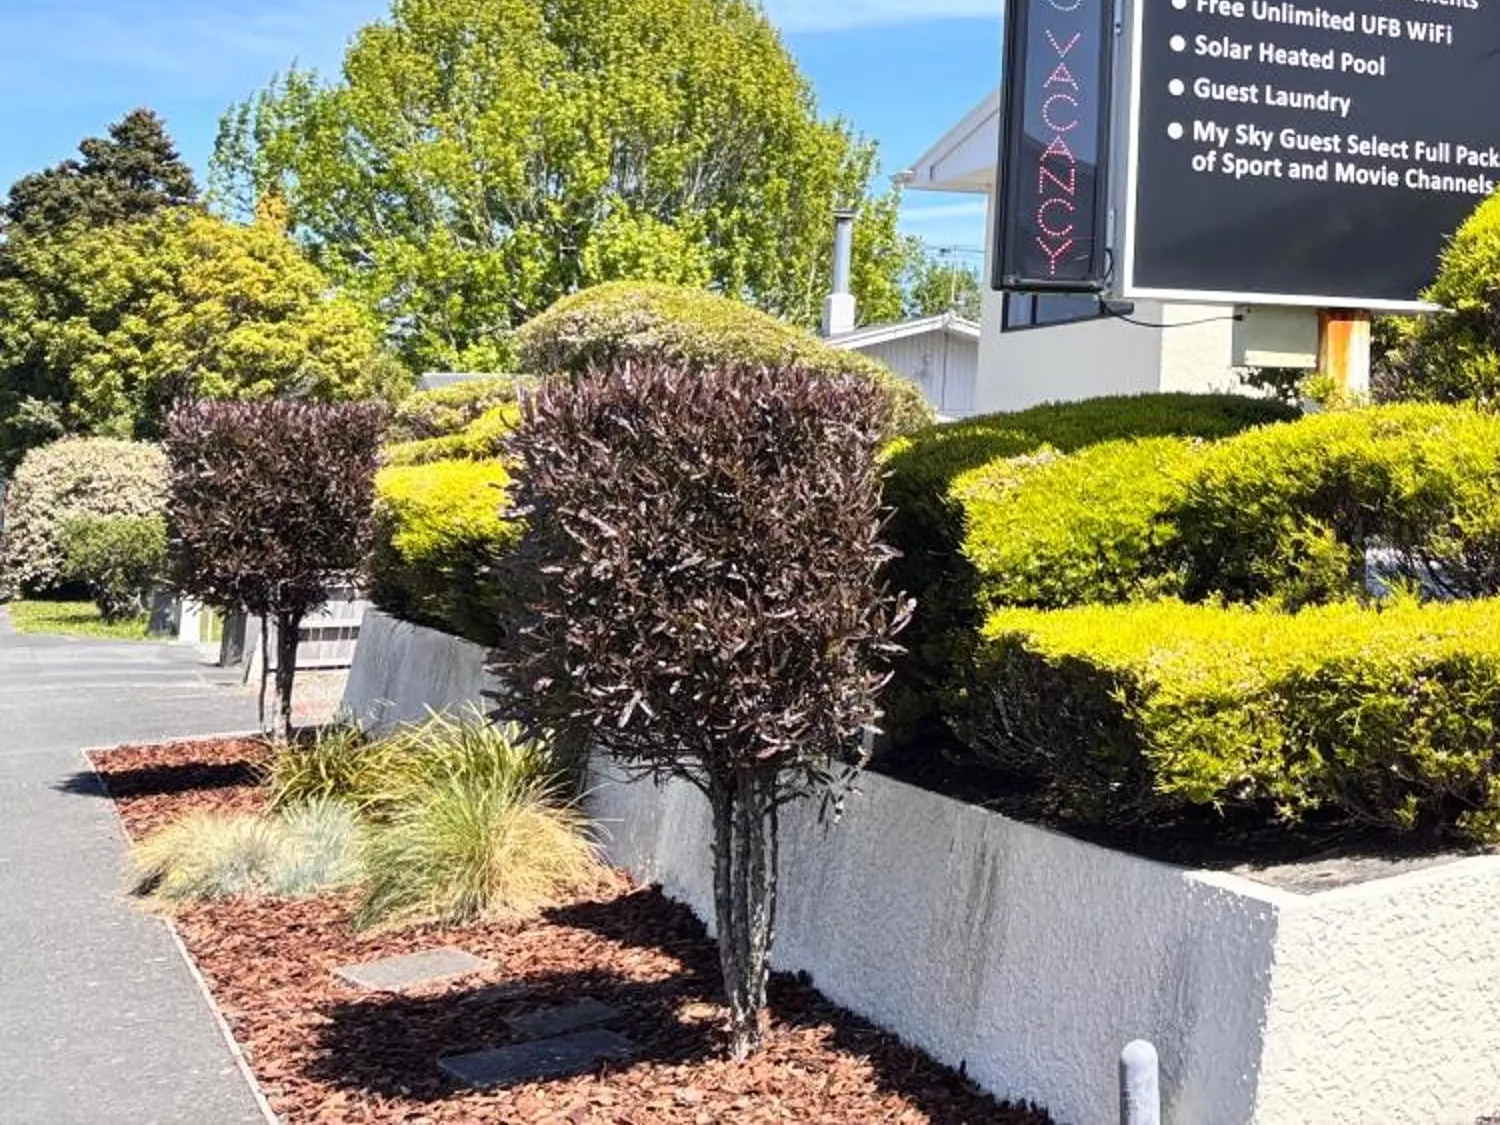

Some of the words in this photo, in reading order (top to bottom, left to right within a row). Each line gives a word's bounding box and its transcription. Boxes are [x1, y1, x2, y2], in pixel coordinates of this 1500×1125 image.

[1251, 0, 1355, 32] Unlimited
[1361, 14, 1401, 38] UFB
[1407, 20, 1453, 45] WiFi
[1194, 34, 1252, 60] Solar
[1258, 42, 1335, 70] Heated
[1340, 52, 1386, 76] Pool
[1193, 77, 1259, 104] Guest
[1265, 84, 1351, 119] Laundry
[1035, 28, 1081, 276] VACANCY
[1193, 120, 1229, 148] My
[1235, 123, 1274, 152] Sky
[1279, 128, 1342, 154] Guest
[1347, 134, 1409, 160] Select
[1415, 141, 1450, 164] Full
[1191, 150, 1217, 172] of
[1221, 152, 1283, 180] Sport
[1287, 160, 1329, 181] and
[1334, 162, 1400, 188] Movie
[1405, 168, 1494, 196] Channels
